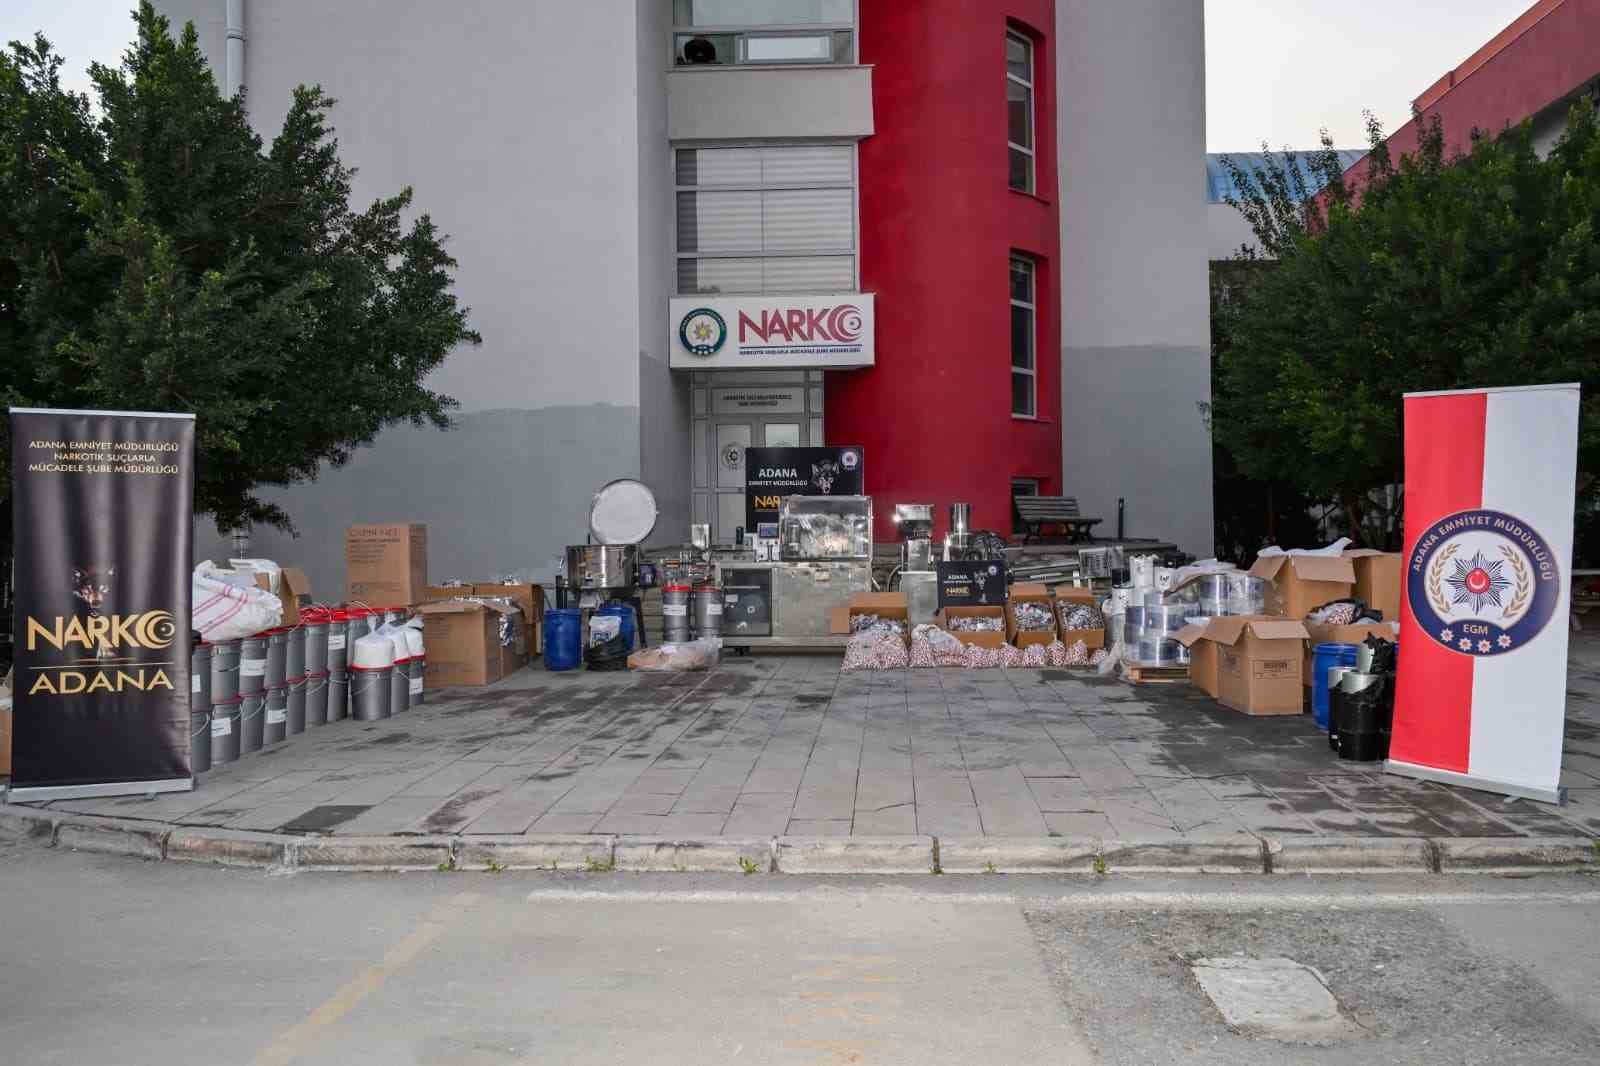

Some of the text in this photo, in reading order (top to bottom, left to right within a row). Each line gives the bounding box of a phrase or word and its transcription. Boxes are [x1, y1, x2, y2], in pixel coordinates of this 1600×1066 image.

[28, 440, 178, 452] ADANA EMNİYET MÜDÜRLÜĞÜ
[107, 453, 156, 463] SUÇLARLA
[28, 463, 178, 474] MÜCADELE ŞUBE MÜDÜRLÜĞÜ
[758, 468, 798, 478] ADANA
[755, 496, 780, 508] NAR
[1414, 515, 1553, 580] ADANA EMNİYET MÜDÜRLÜĞÜ
[27, 610, 175, 651] NARKO
[1463, 624, 1488, 635] EGM
[29, 669, 174, 695] ADANA
